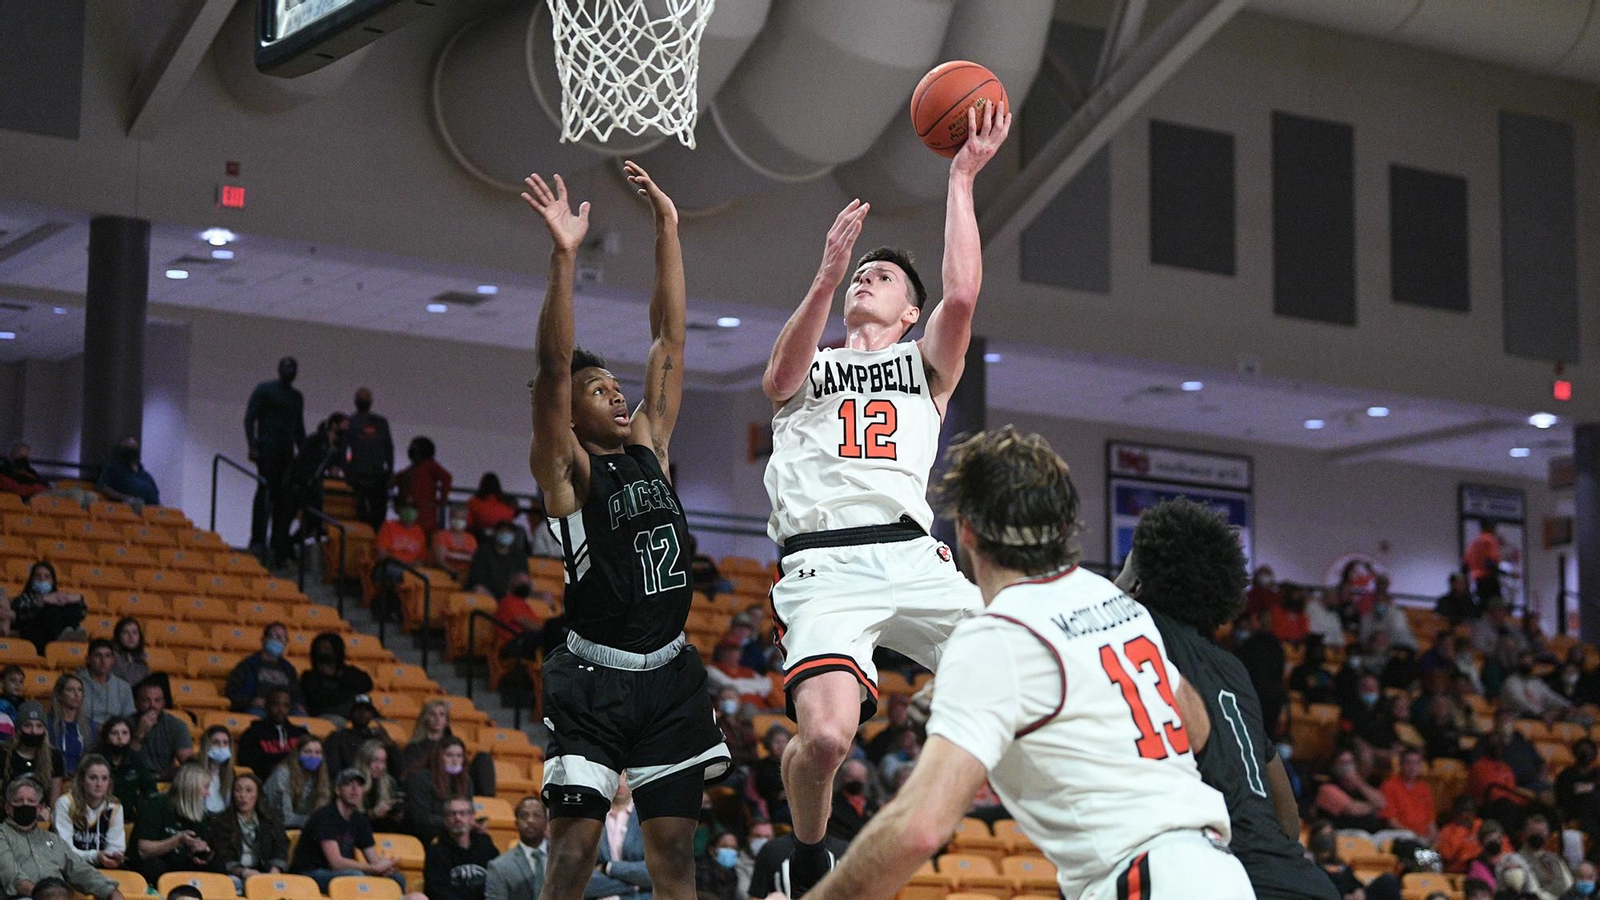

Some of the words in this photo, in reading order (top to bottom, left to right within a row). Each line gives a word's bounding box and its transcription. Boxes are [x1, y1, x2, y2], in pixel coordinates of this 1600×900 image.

[809, 355, 921, 399] CAMPBELL
[838, 398, 898, 461] 12
[633, 523, 687, 595] 12
[1098, 634, 1190, 760] 13
[1218, 689, 1266, 798] 1
